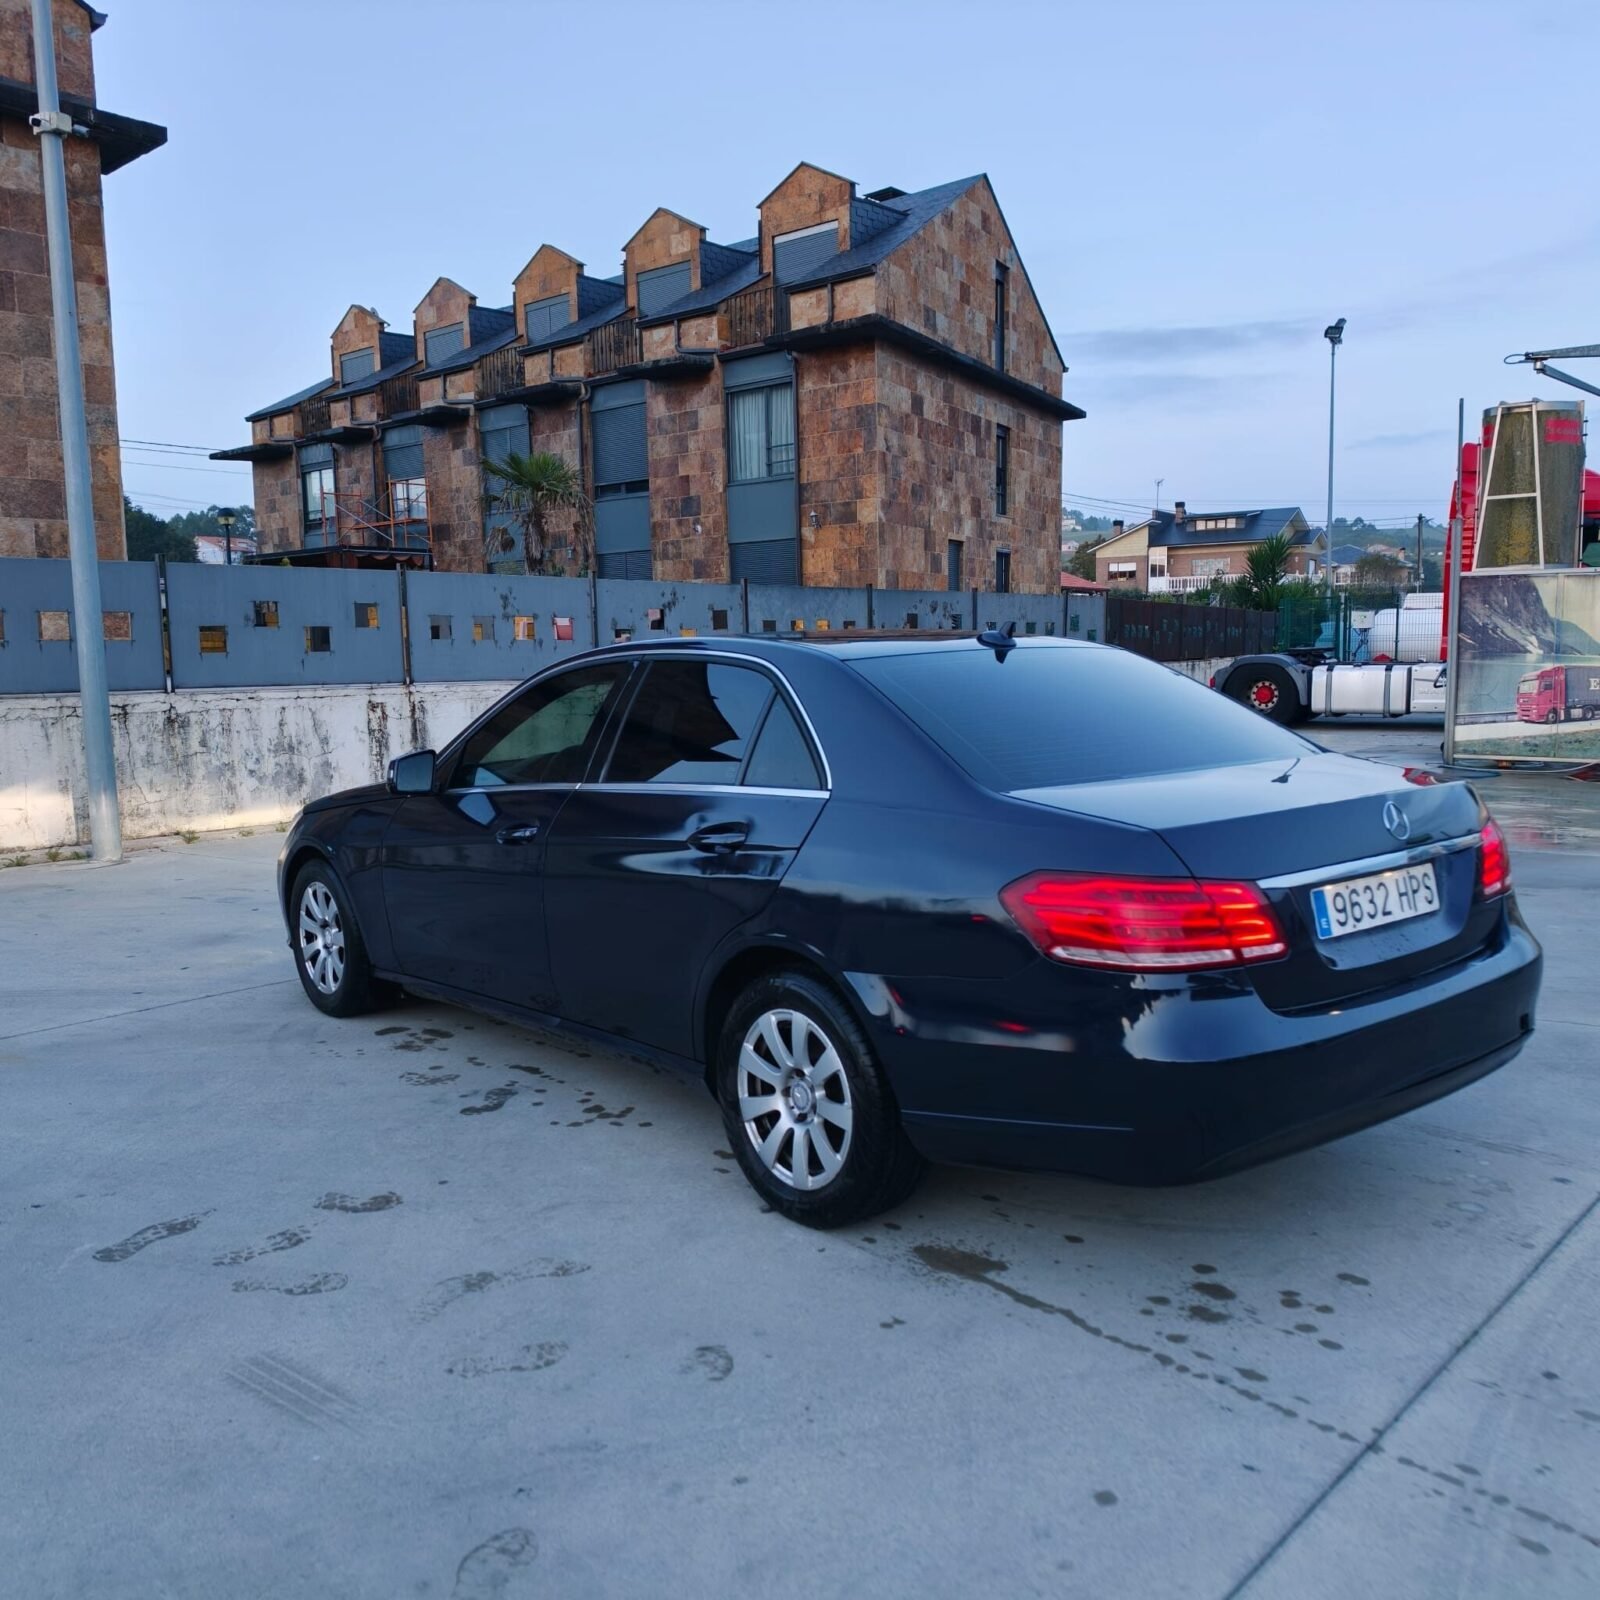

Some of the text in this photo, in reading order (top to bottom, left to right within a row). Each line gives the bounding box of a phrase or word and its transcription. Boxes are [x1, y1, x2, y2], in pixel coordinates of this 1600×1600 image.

[1333, 872, 1434, 927] 9632 HPS
[1320, 918, 1329, 929] E
